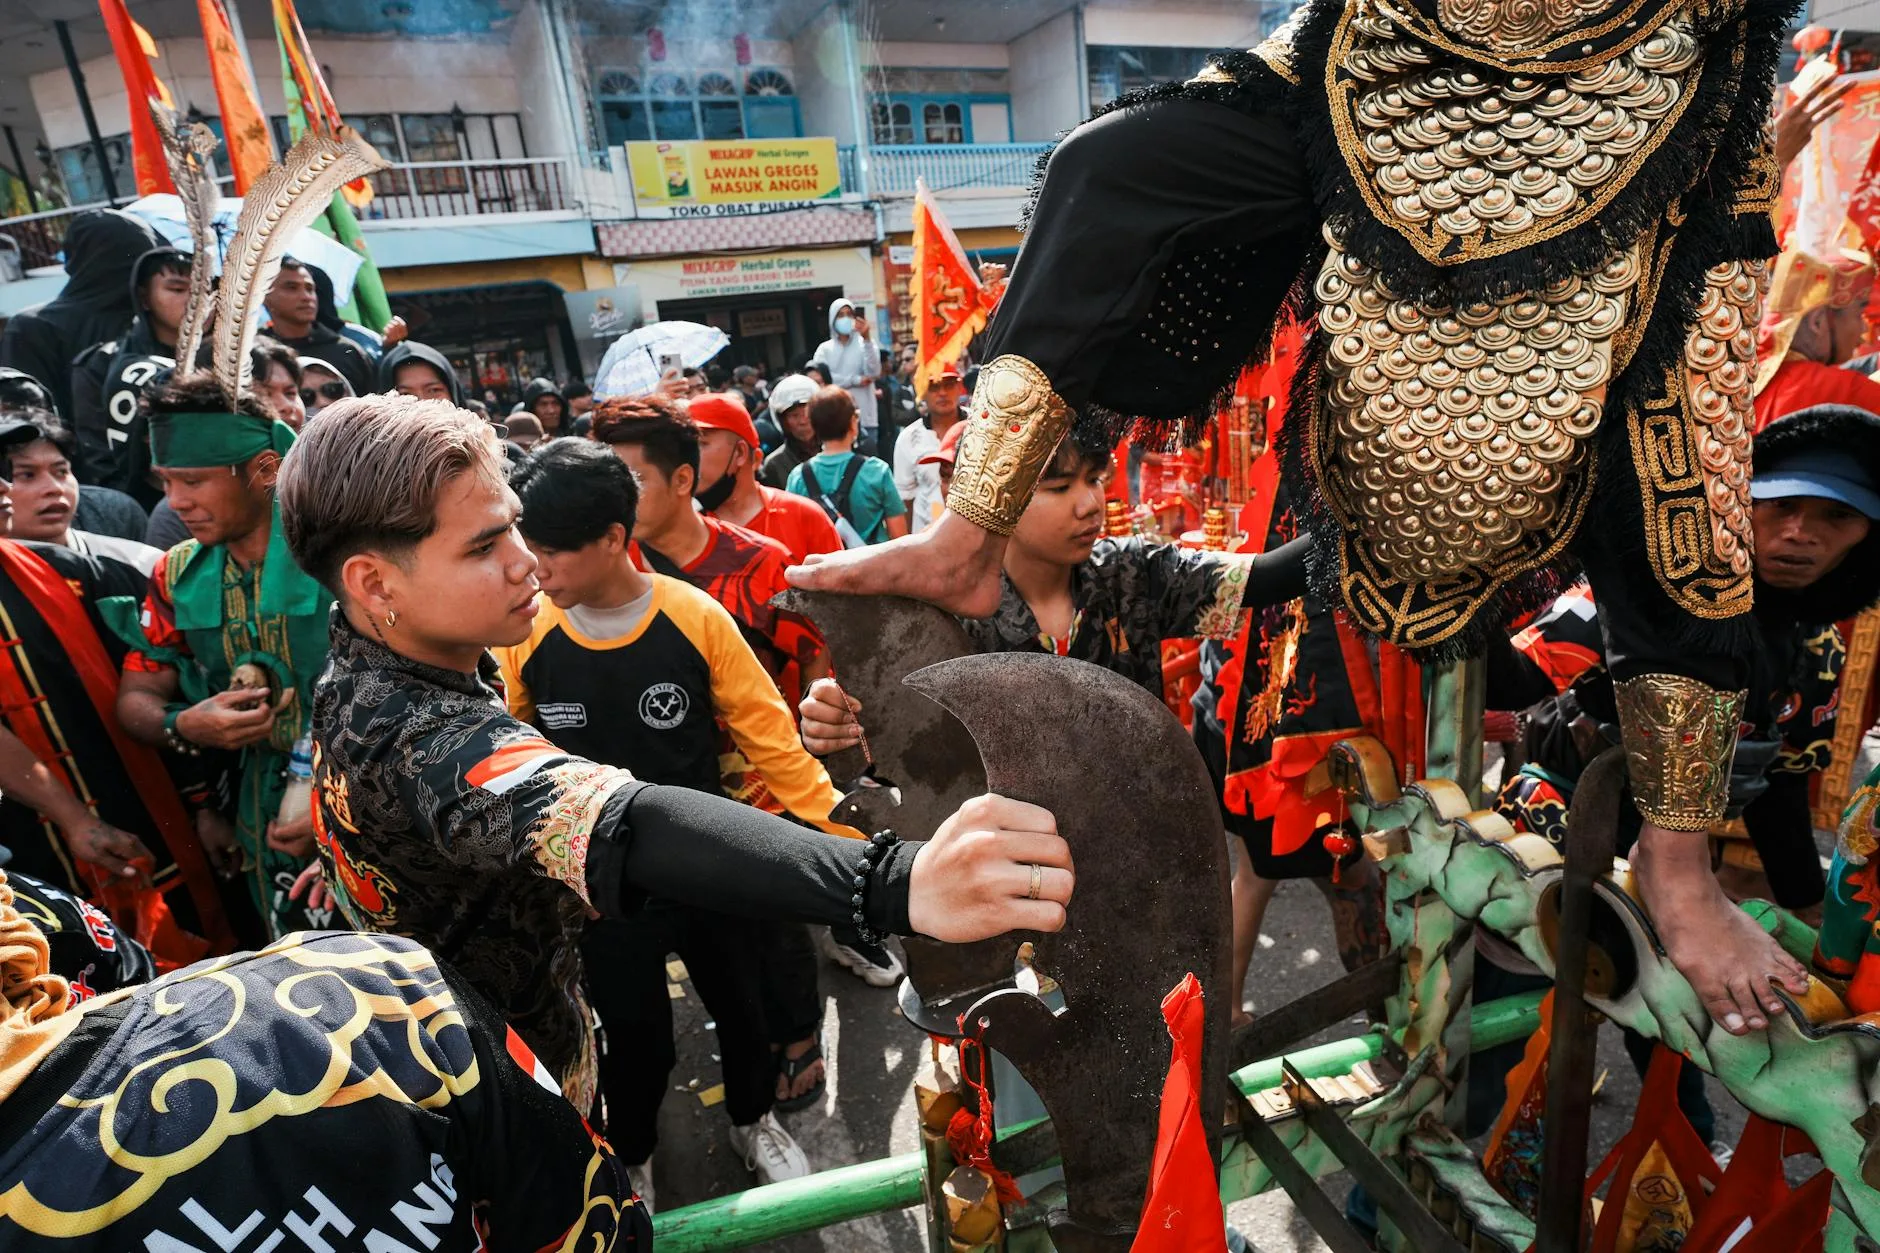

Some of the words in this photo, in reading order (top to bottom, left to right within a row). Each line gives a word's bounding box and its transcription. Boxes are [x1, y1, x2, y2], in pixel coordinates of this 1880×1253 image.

[708, 148, 755, 161] MIXAGRIP
[757, 149, 781, 158] Herbal
[784, 148, 810, 158] Greges
[704, 166, 760, 180] LAWAN
[764, 164, 819, 178] GREGES
[710, 180, 764, 194] MASUK
[769, 179, 818, 192] ANGIN
[669, 204, 711, 217] TOKO
[716, 203, 753, 216] OBAT
[760, 201, 817, 213] PUSAKA
[682, 259, 737, 274] MIXAGRIP
[740, 260, 774, 271] Herbal
[777, 258, 811, 270] Greges
[709, 275, 740, 285] YANG
[687, 288, 717, 296] LAWAN
[753, 282, 781, 290] MASUK
